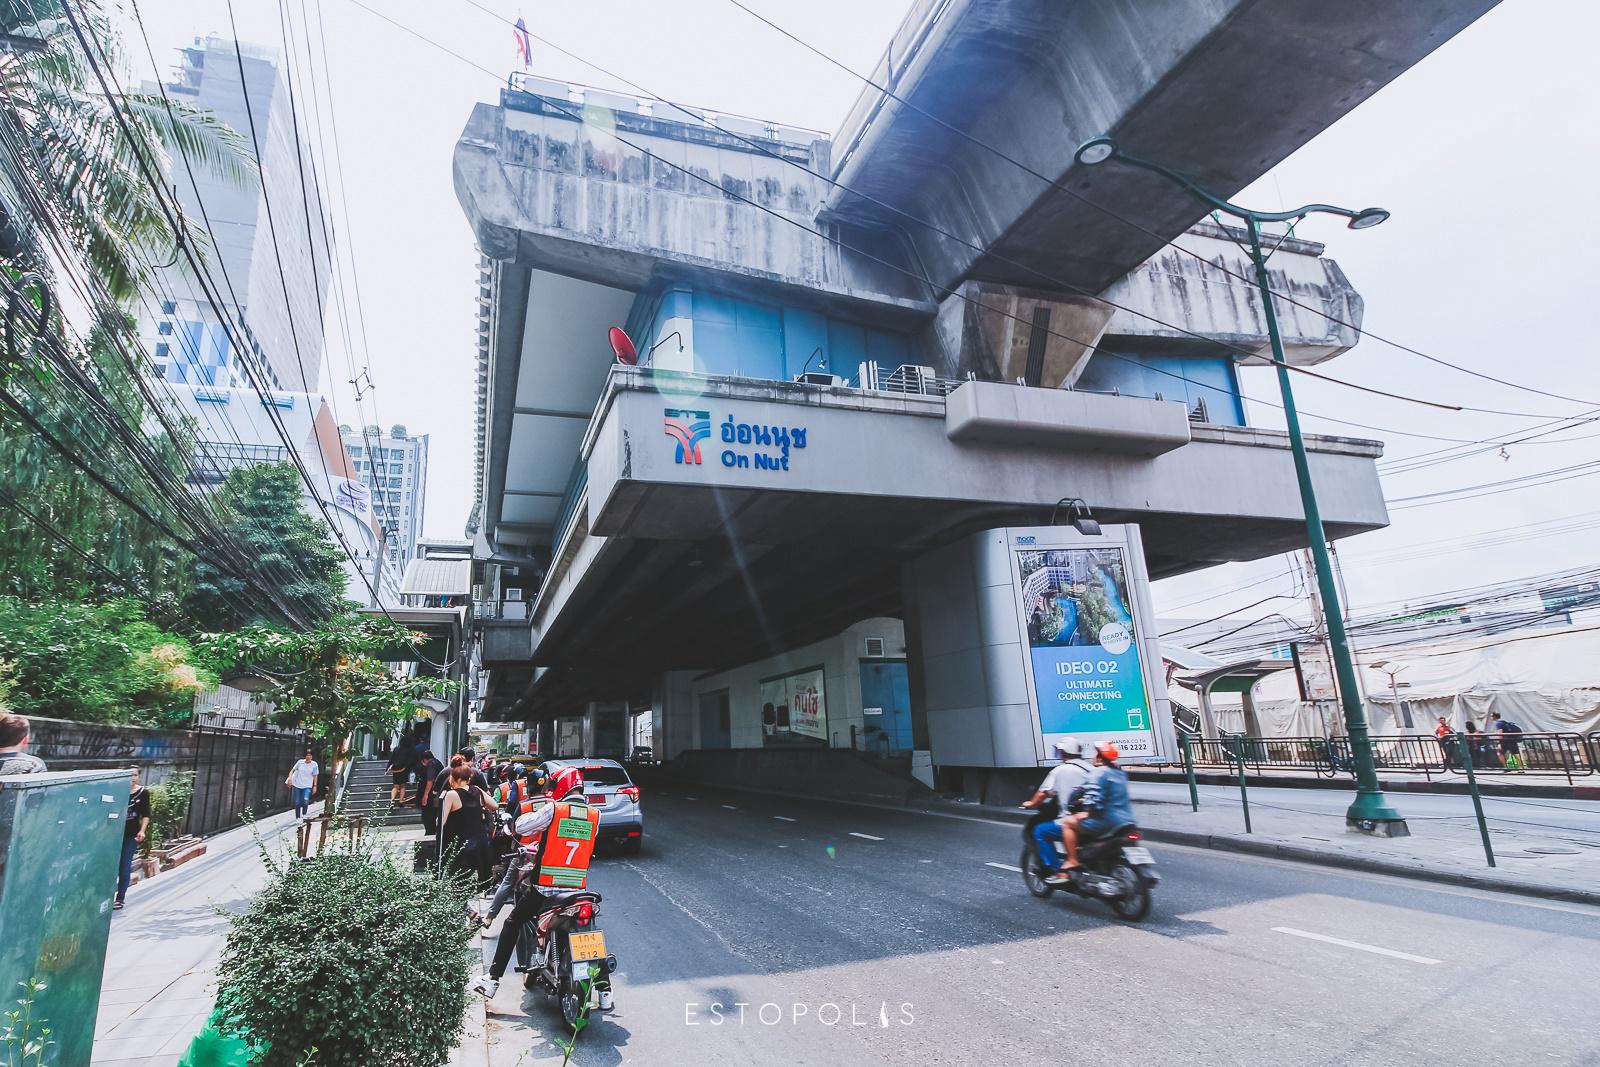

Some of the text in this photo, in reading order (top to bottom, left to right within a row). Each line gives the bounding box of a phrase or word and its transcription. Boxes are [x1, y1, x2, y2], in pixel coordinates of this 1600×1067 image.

[664, 408, 711, 419] BTS
[721, 414, 807, 457] อ่อนนุช
[721, 450, 789, 471] On Nut
[1103, 631, 1123, 640] READY
[1055, 661, 1094, 675] IDEO
[1066, 679, 1114, 689] ULTIMATE
[1058, 690, 1122, 701] CONNECTING
[1079, 702, 1107, 712] POOL
[565, 841, 580, 865] 7
[580, 950, 598, 959] 512
